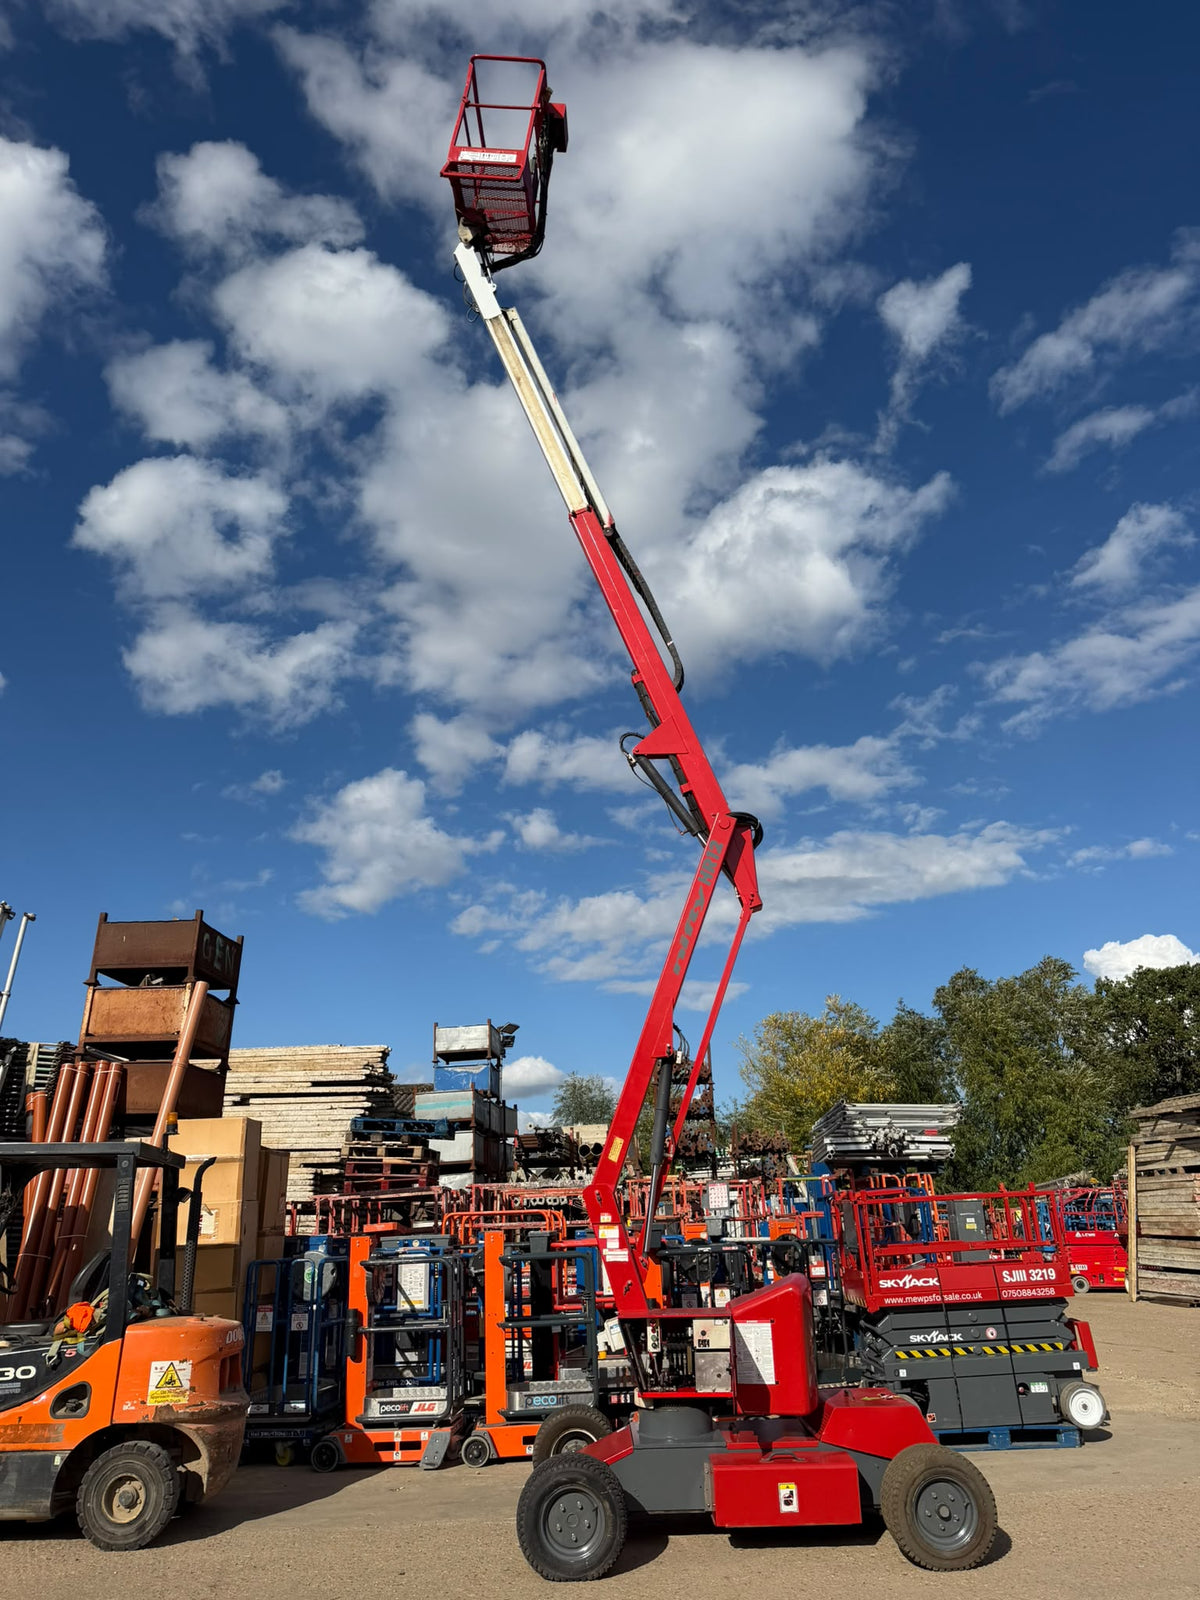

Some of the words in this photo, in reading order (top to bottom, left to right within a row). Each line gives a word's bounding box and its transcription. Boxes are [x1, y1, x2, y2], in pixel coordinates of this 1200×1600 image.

[697, 839, 724, 887] HR12
[1028, 1267, 1056, 1281] 3219
[879, 1274, 940, 1289] SKYJACK
[1001, 1287, 1056, 1298] 07508843258
[0, 1365, 37, 1381] 30
[380, 1402, 409, 1415] pecolift
[414, 1402, 437, 1412] JLG
[525, 1395, 570, 1409] pecolift
